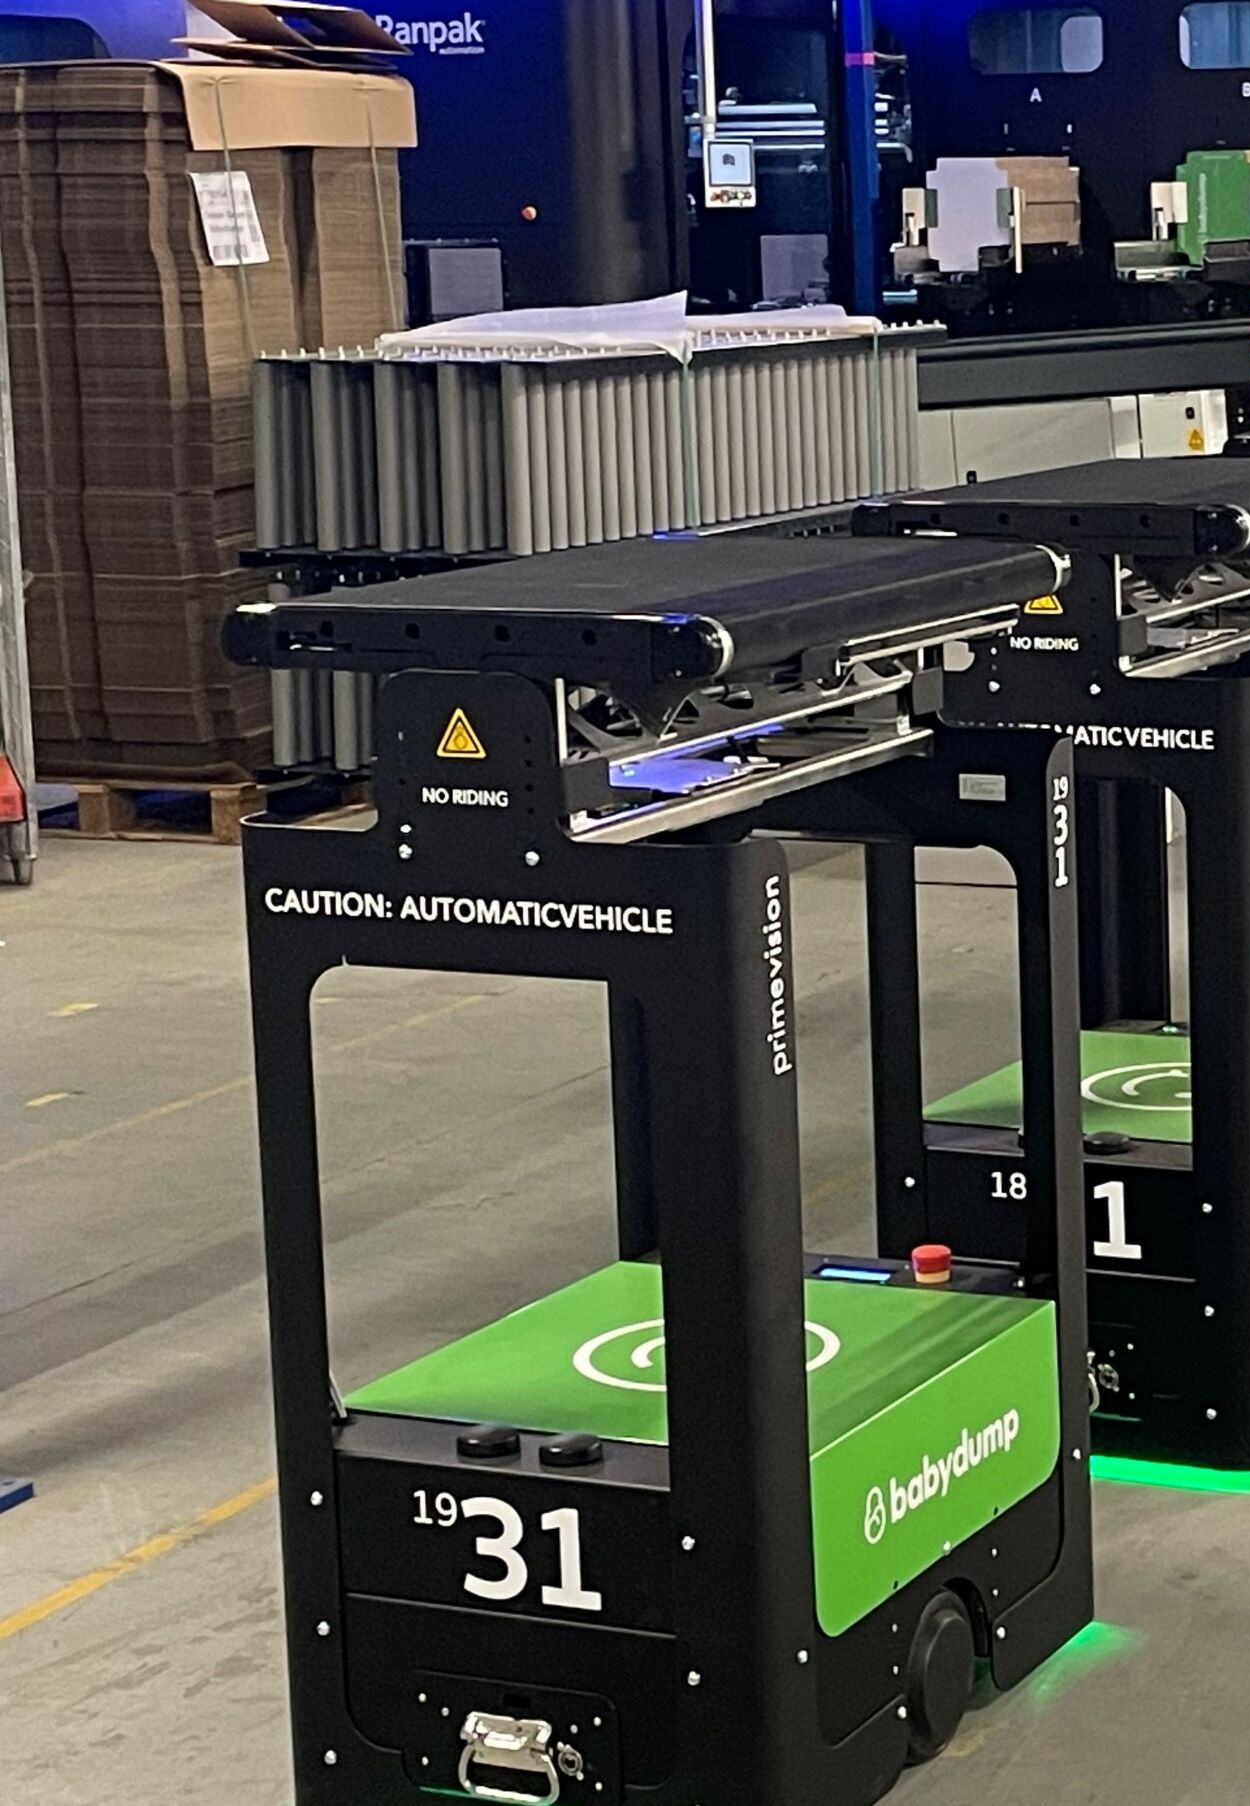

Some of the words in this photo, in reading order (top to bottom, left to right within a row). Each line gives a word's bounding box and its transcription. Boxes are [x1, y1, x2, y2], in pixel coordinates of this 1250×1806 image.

[1029, 87, 1043, 102] A
[1009, 636, 1032, 650] NO
[1033, 636, 1079, 651] RIDING
[422, 787, 450, 805] NO
[452, 789, 509, 808] RIDING
[264, 887, 393, 918] CAUTION:
[762, 874, 794, 1075] primevision
[991, 1171, 1027, 1200] 18
[889, 1408, 1020, 1524] babydump
[460, 1496, 602, 1611] 31
